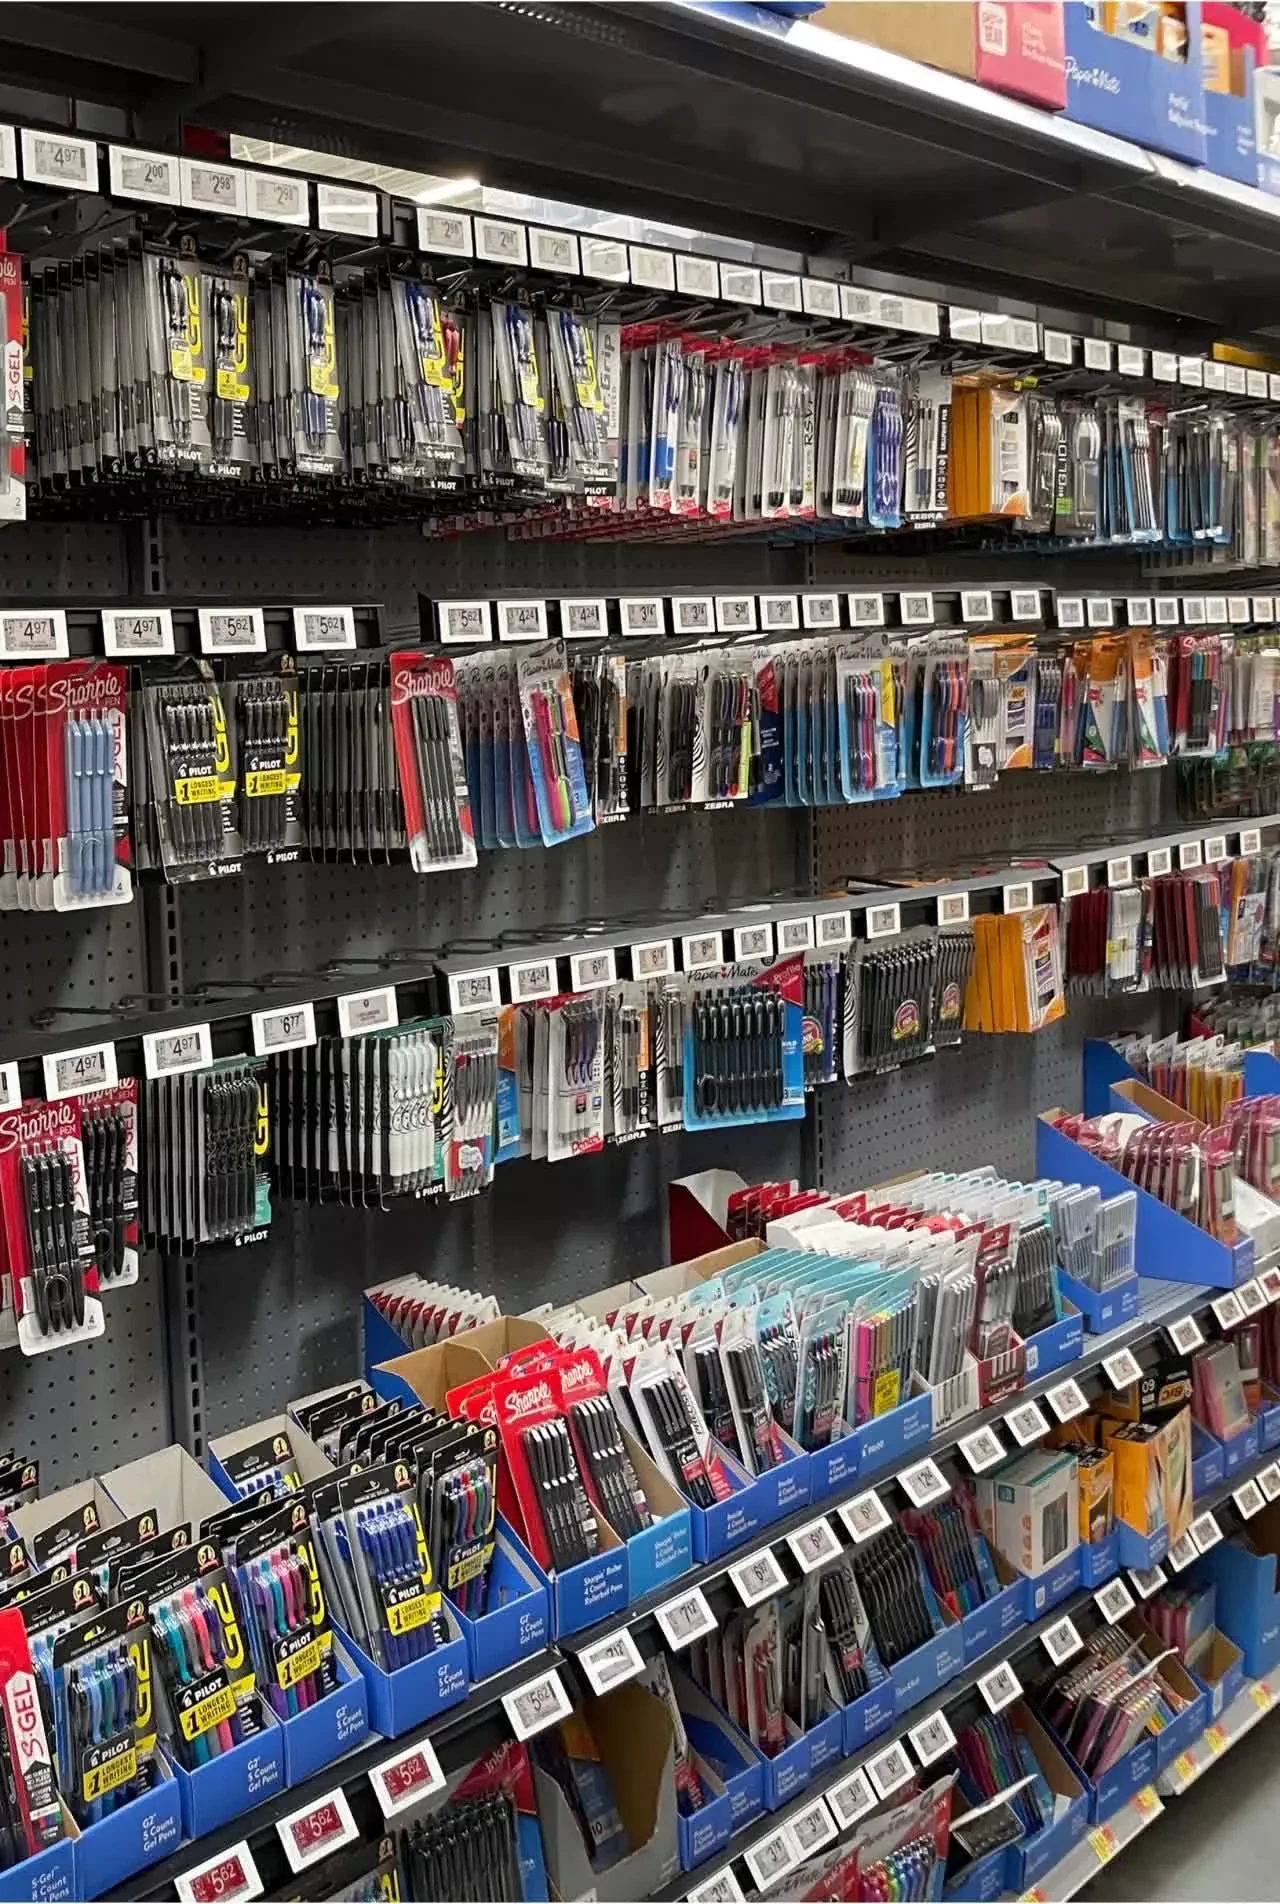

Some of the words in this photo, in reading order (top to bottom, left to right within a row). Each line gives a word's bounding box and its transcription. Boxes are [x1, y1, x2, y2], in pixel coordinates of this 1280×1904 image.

[177, 450, 201, 460] PILOT
[218, 465, 241, 476] PILOT
[437, 481, 456, 490] PILOT
[584, 487, 607, 495] PILOT
[34, 672, 121, 714] Sharpie
[393, 669, 456, 702] Sharpie
[189, 765, 212, 776] PILOT
[260, 759, 281, 770] PILOT
[191, 780, 215, 789] LONGEST
[260, 773, 283, 782] LONGEST
[260, 781, 284, 790] WRITING
[192, 788, 216, 796] WRITING
[704, 801, 734, 811] ZEBRA
[276, 851, 298, 862] PILOT
[218, 863, 241, 874] PILOT
[687, 967, 721, 983] Paper
[727, 964, 758, 979] Mate
[59, 1125, 76, 1135] PEN
[618, 1130, 647, 1144] ZEBRA
[422, 1184, 443, 1196] PILOT
[244, 1230, 268, 1243] PILOT
[505, 1379, 553, 1423] Sharpie
[461, 1543, 481, 1558] PILOT
[398, 1584, 420, 1601] PILOT
[401, 1599, 425, 1614] LONGEST
[404, 1607, 427, 1622] WRITING
[525, 1618, 543, 1635] Count
[289, 1632, 311, 1653] PILOT
[520, 1633, 532, 1645] Gel
[532, 1627, 544, 1640] Pens
[292, 1644, 316, 1666] LONGEST
[293, 1654, 317, 1674] WRITING
[444, 1669, 463, 1686] Count
[194, 1679, 222, 1701] PILOT
[439, 1685, 452, 1698] Gel
[452, 1678, 465, 1692] Pens
[198, 1692, 229, 1716] LONGEST
[200, 1701, 231, 1725] WRITING
[343, 1710, 362, 1727] Count
[338, 1727, 350, 1740] Gel
[351, 1719, 365, 1734] Pens
[101, 1739, 130, 1761] PILOT
[102, 1754, 132, 1776] LONGEST
[103, 1763, 133, 1784] WRITING
[254, 1760, 277, 1778] Count
[248, 1780, 261, 1793] Gel
[262, 1771, 278, 1788] Pens
[150, 1817, 174, 1836] Count
[144, 1837, 157, 1852] Gel
[158, 1827, 176, 1844] Pens
[39, 1876, 67, 1894] Count
